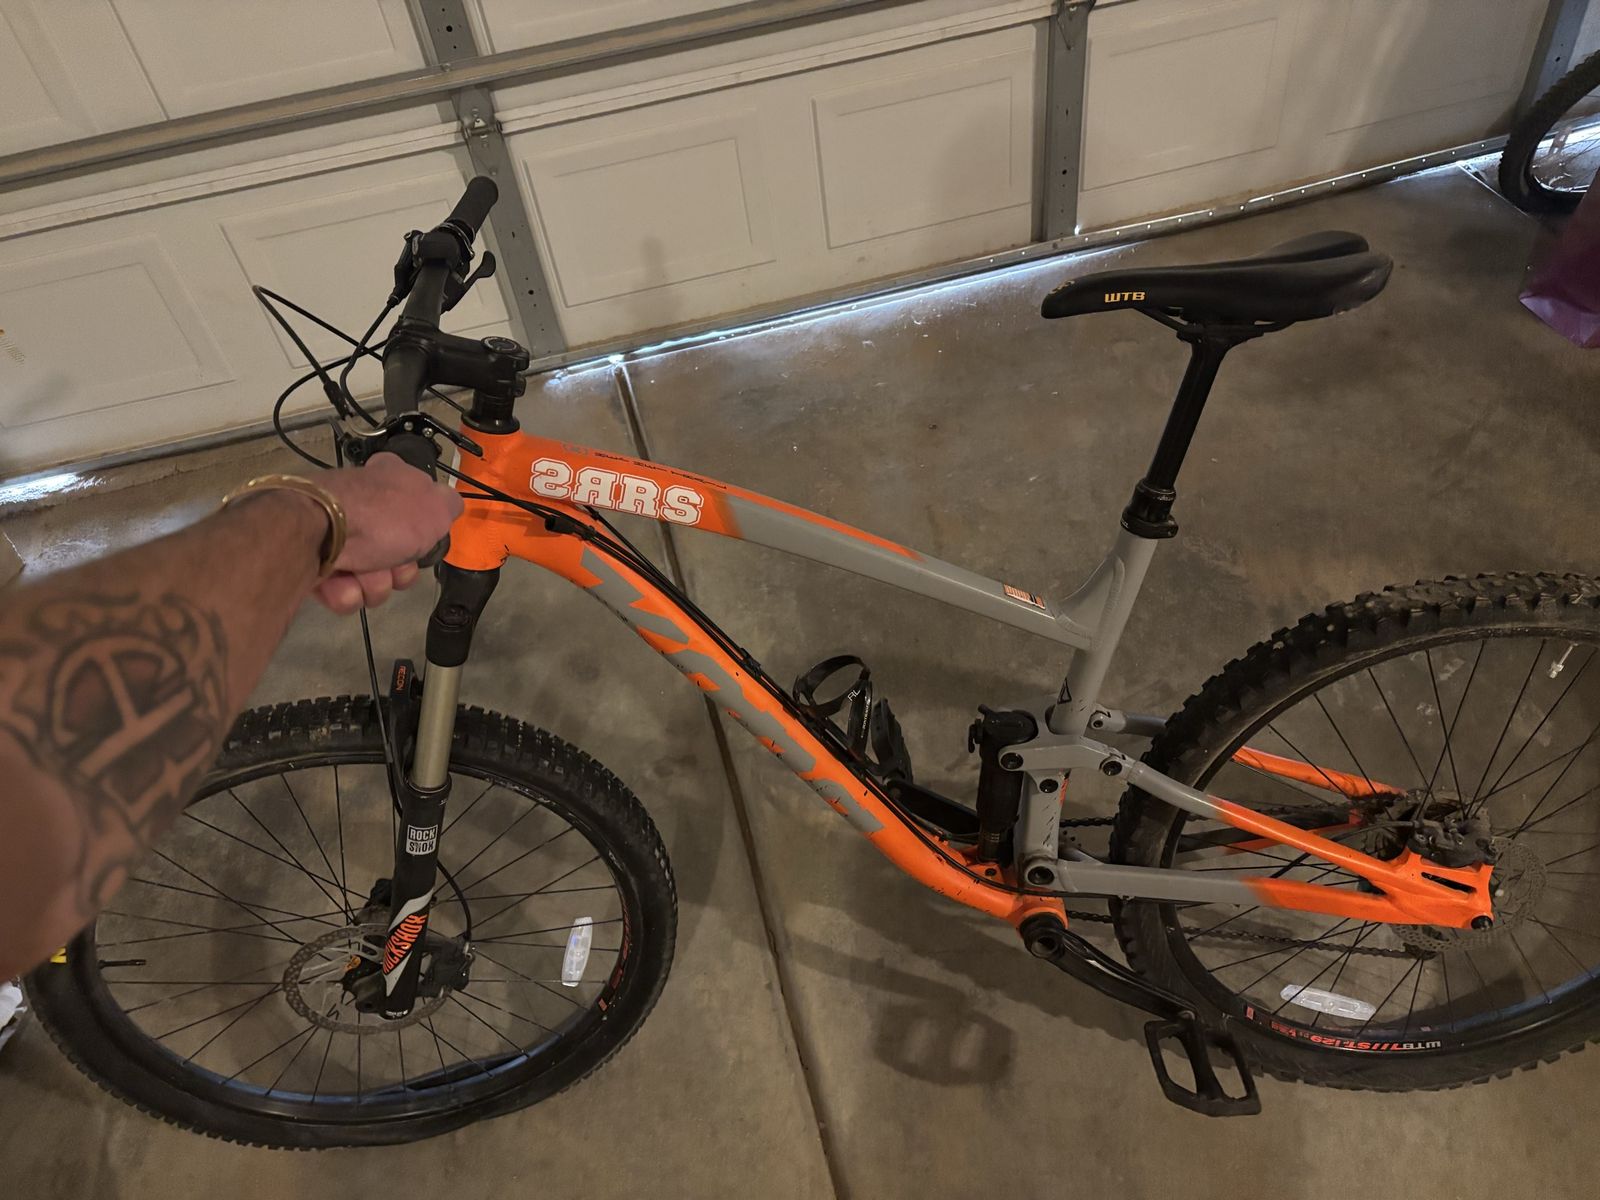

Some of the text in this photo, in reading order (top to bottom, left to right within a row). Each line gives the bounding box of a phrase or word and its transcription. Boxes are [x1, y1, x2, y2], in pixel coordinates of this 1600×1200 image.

[1104, 291, 1146, 303] WTB
[409, 828, 437, 841] ROCK
[1402, 1040, 1442, 1050] WTB
